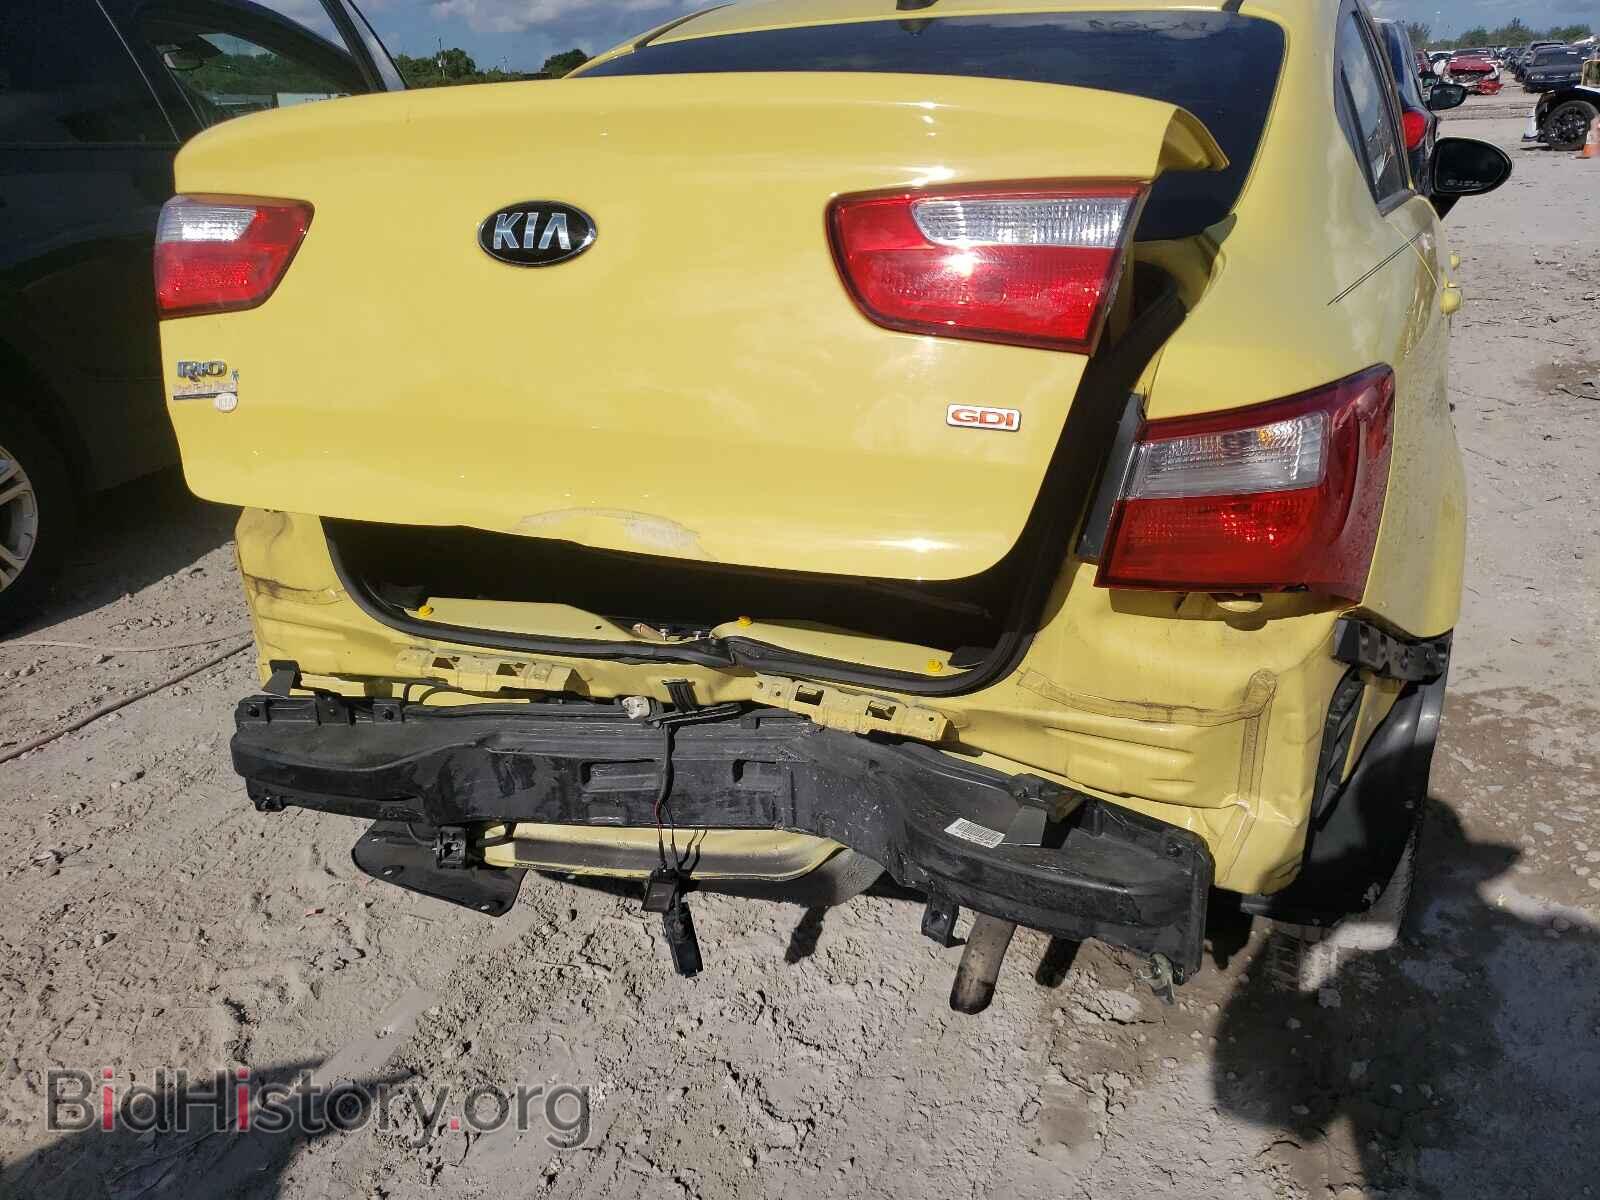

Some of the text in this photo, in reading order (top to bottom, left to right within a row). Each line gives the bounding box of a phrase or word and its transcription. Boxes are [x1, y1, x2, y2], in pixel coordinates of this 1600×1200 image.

[493, 212, 572, 250] KIA
[177, 360, 227, 381] RIO
[951, 408, 1015, 426] GDI
